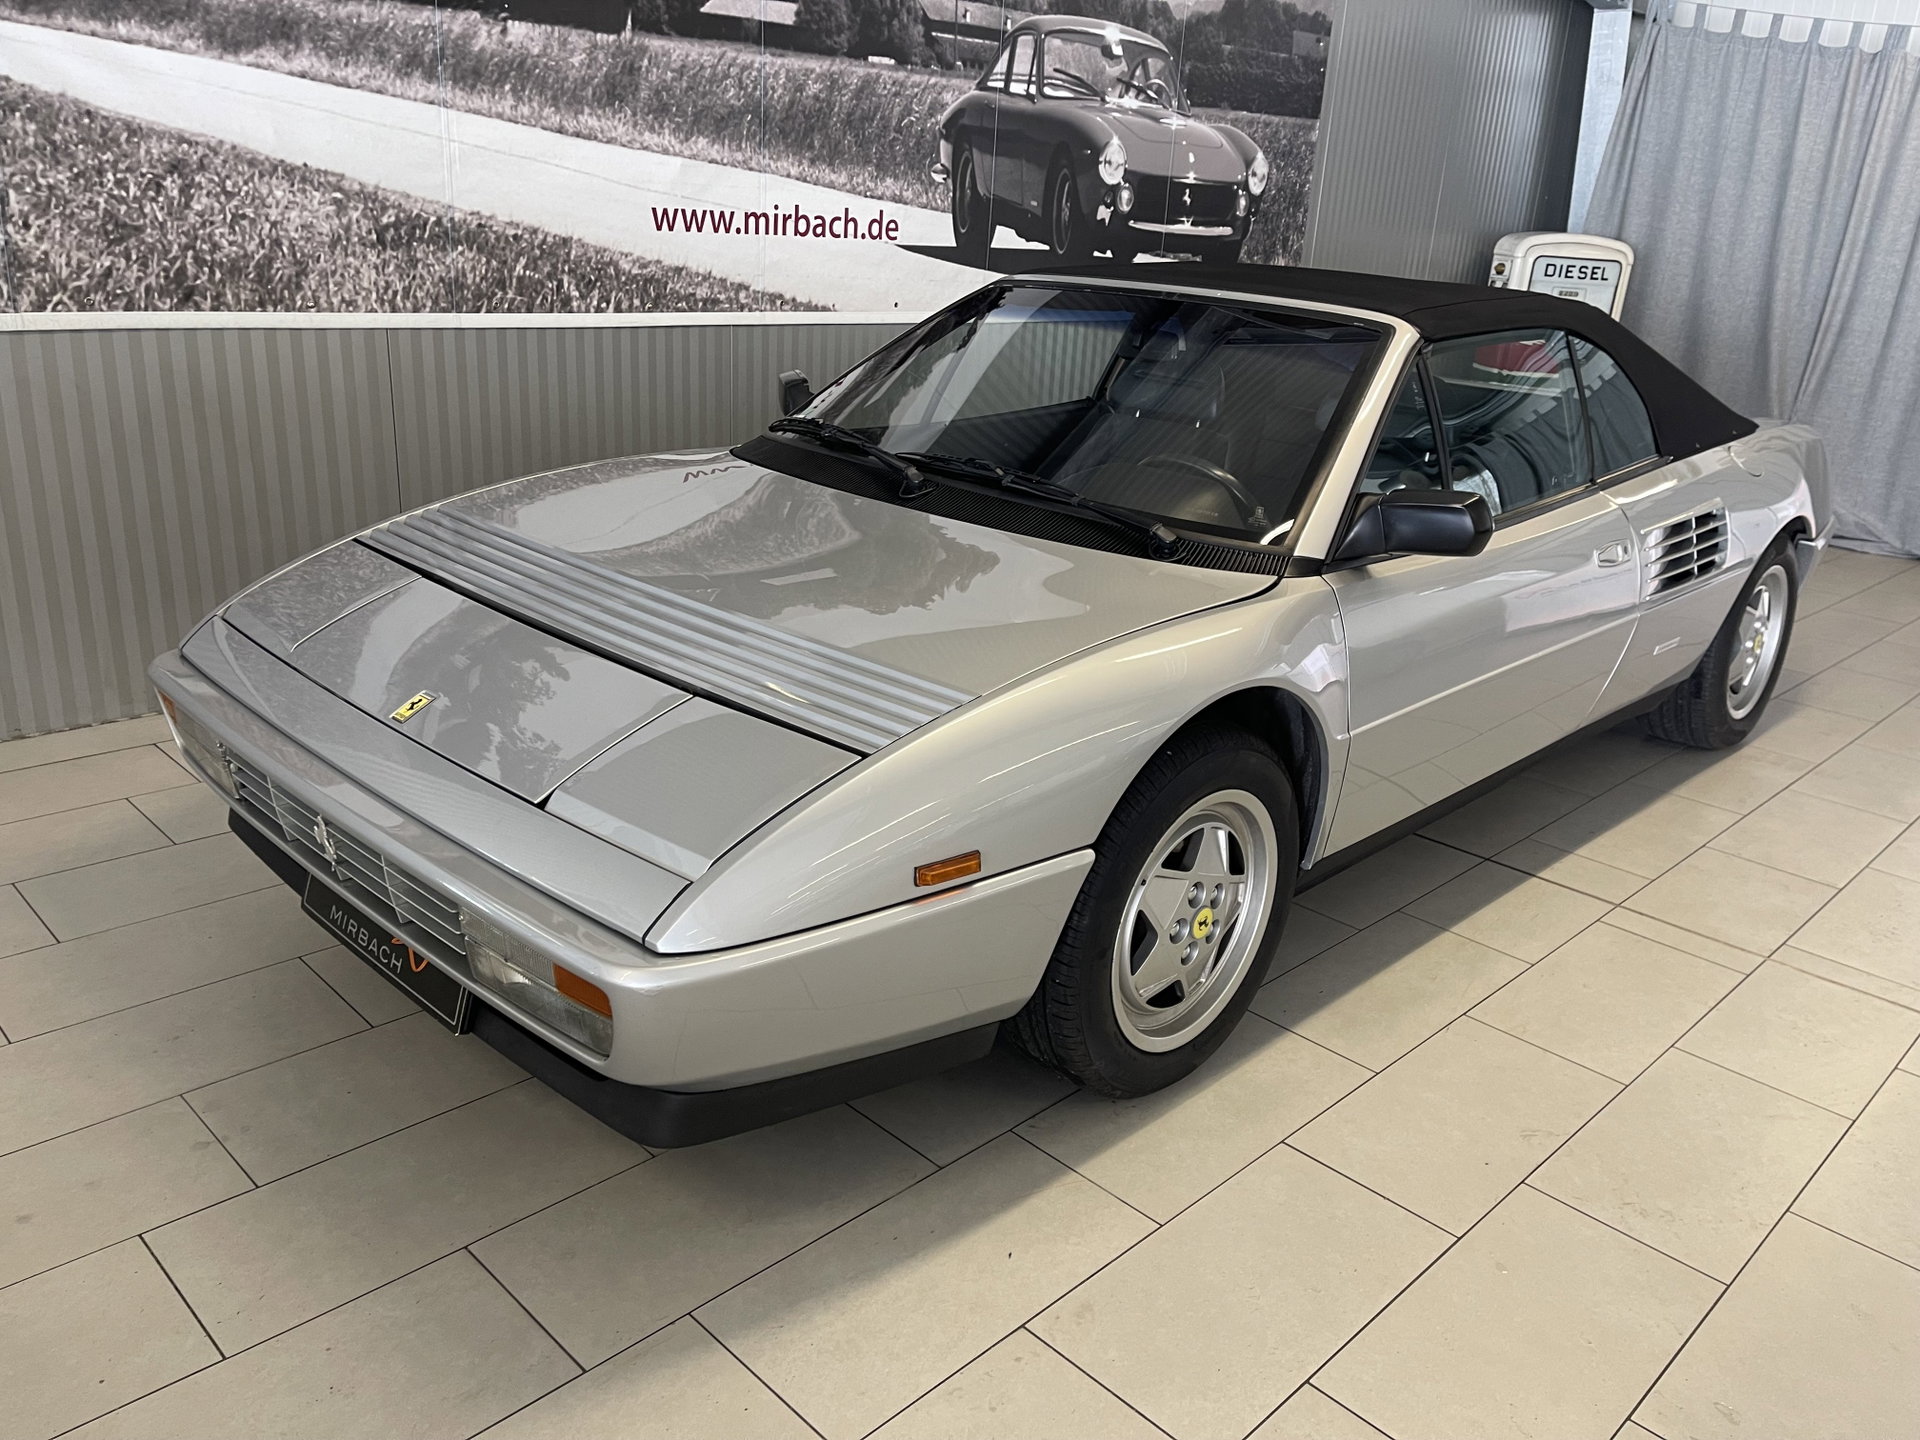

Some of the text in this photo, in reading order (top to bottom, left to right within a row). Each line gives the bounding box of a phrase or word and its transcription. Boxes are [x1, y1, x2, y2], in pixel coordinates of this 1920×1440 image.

[651, 204, 899, 241] www.mirbach.de
[1544, 263, 1609, 281] DIESEL
[329, 904, 403, 974] MIRBACH
